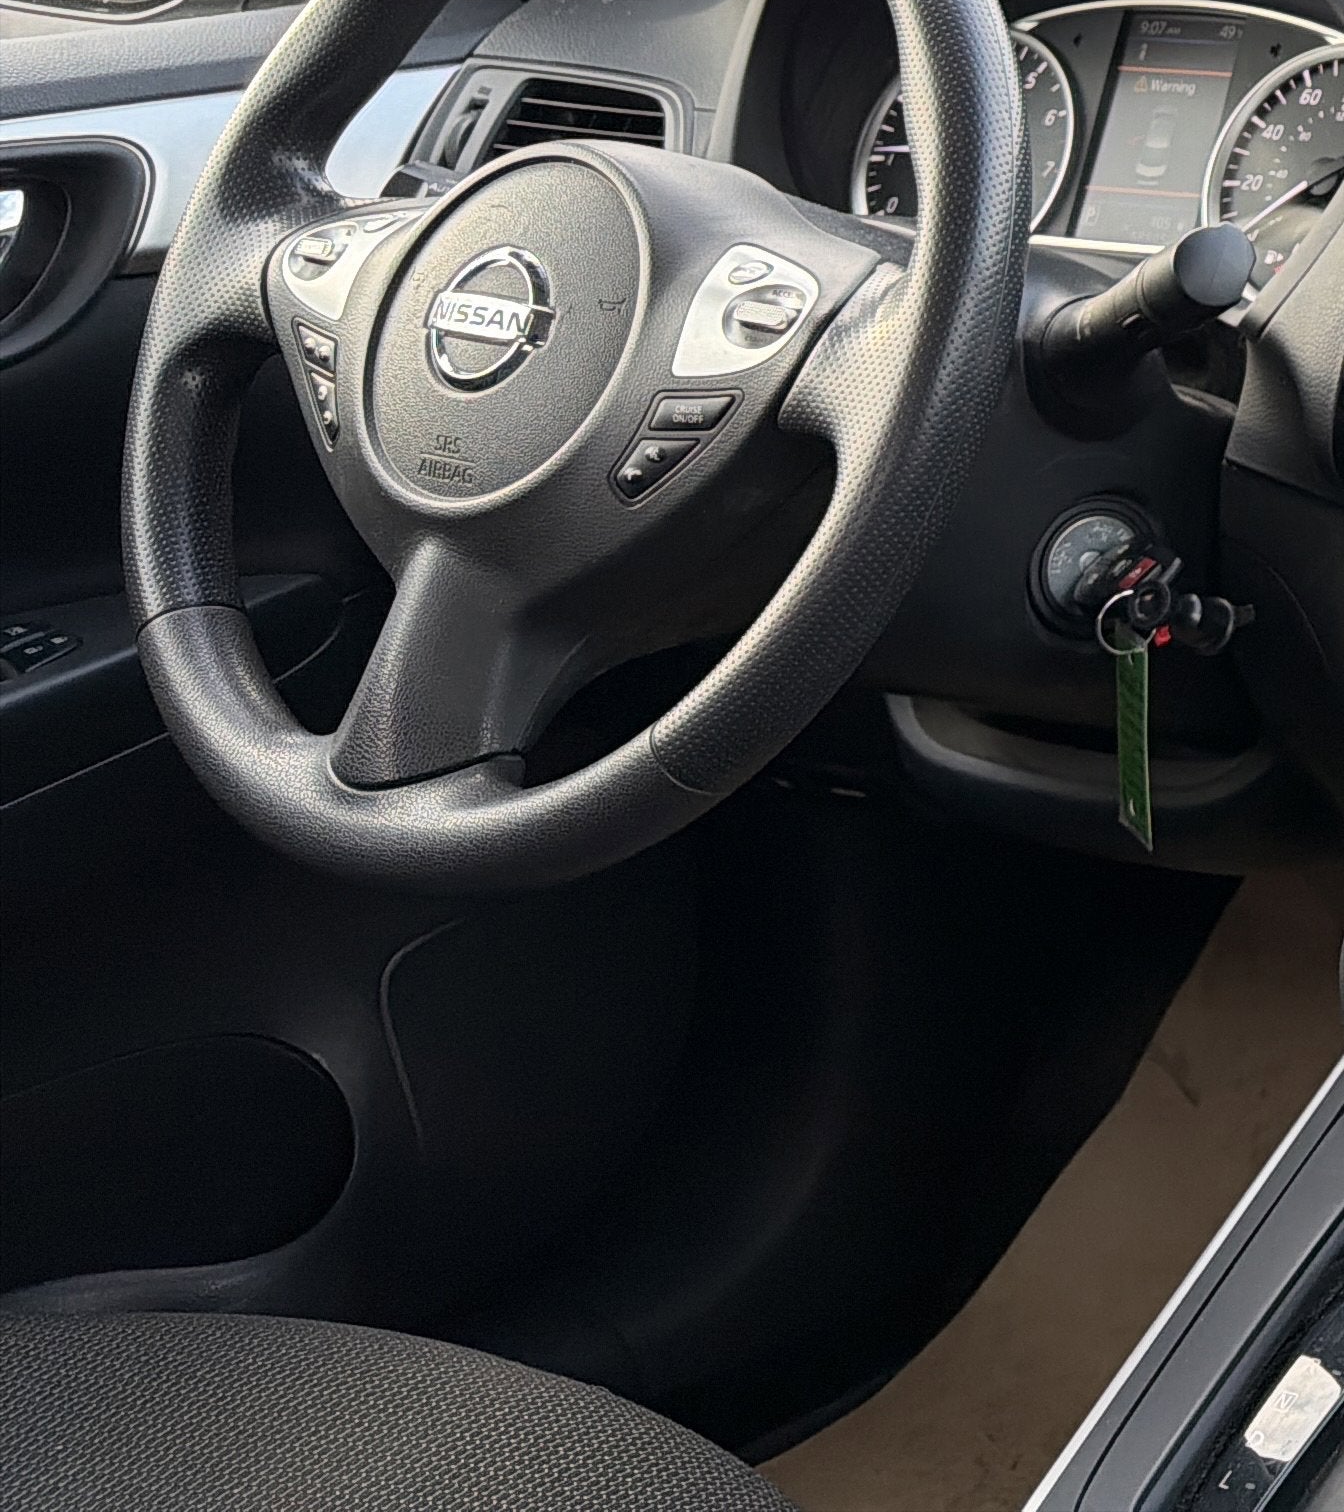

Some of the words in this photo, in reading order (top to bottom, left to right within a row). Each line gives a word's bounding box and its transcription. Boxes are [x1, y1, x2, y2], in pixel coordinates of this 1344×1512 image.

[1024, 71, 1039, 90] 5
[1151, 79, 1196, 96] Warning
[1299, 88, 1322, 105] 60
[1044, 109, 1058, 126] 6
[1261, 124, 1285, 140] 40
[1042, 160, 1056, 178] 7
[1241, 174, 1264, 191] 20
[886, 196, 899, 214] 0
[433, 299, 535, 335] NISSAN
[675, 404, 703, 414] CRUISE
[672, 413, 704, 424] ON/OFF
[434, 435, 463, 454] SRS
[417, 457, 475, 485] AIRBAG
[1275, 1395, 1293, 1409] N
[1218, 1469, 1233, 1490] L
